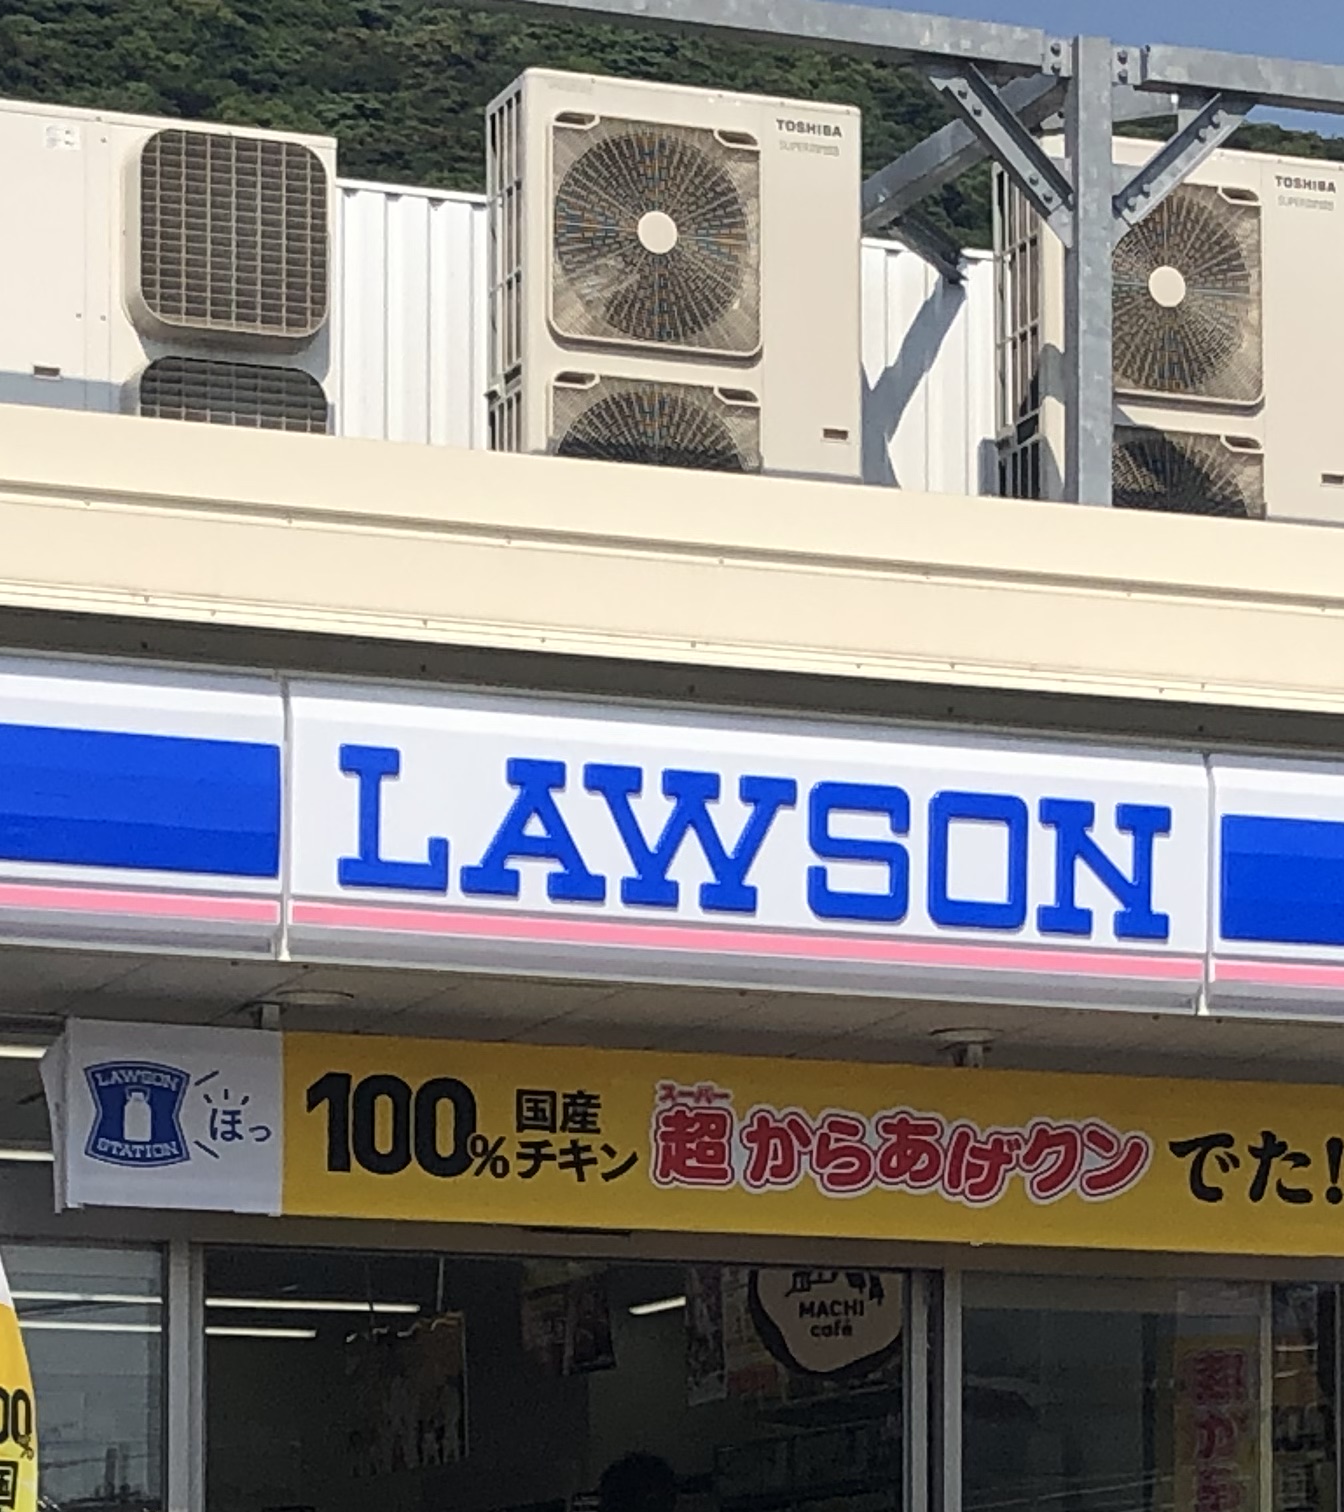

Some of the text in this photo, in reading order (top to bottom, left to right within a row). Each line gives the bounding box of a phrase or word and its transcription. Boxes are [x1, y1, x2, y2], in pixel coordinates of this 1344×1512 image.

[776, 118, 842, 138] TOSHIBA
[1275, 175, 1336, 193] TOSHIBA
[337, 743, 1172, 942] LAWSON
[95, 1068, 181, 1092] LAWSON
[660, 1084, 731, 1101] スーパー
[209, 1107, 272, 1143] ほっ
[306, 1072, 510, 1180] 100%
[514, 1087, 602, 1135] 国産
[96, 1136, 181, 1159] STATION
[514, 1139, 640, 1183] チキン
[654, 1103, 1151, 1203] 超からあげクン
[798, 1297, 865, 1319] MACHI
